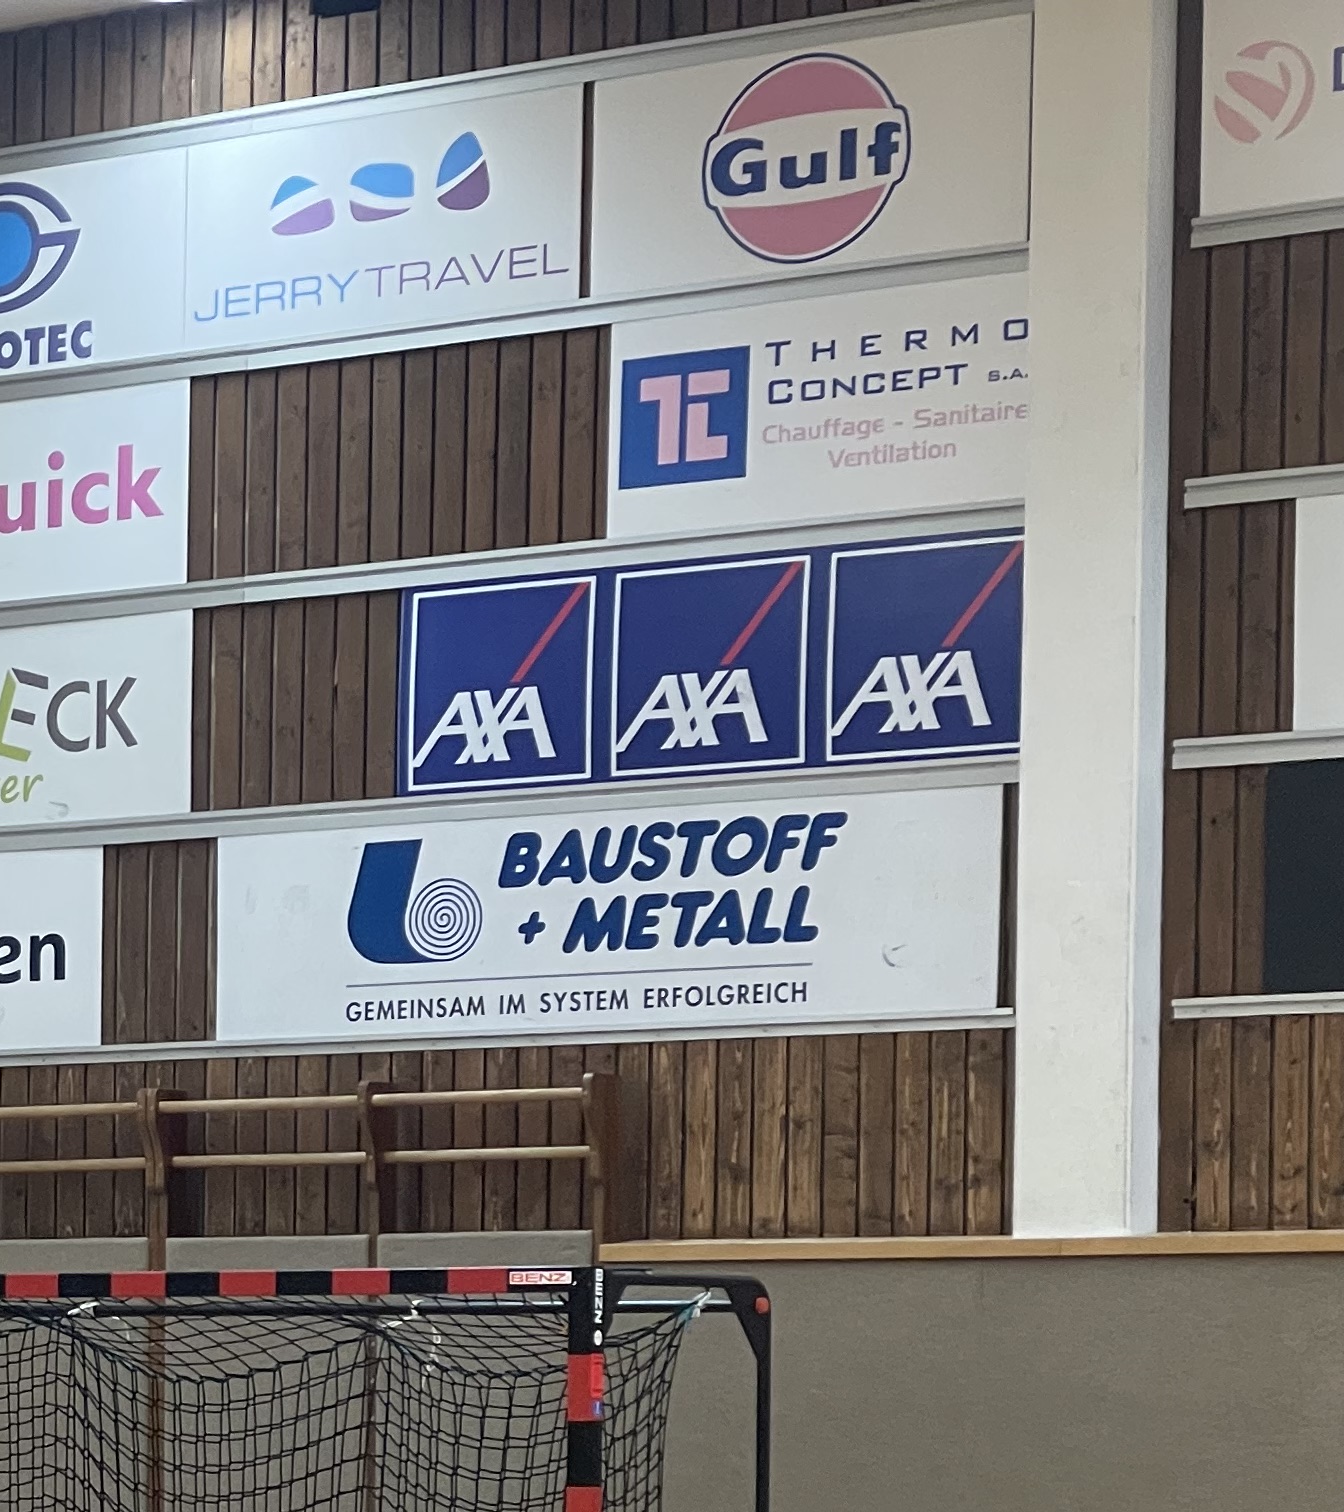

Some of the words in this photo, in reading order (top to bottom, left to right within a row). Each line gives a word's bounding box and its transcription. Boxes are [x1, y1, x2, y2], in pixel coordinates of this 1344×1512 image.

[710, 121, 901, 198] Gulf
[765, 318, 1029, 367] THERMO
[768, 363, 968, 405] CONCEPT
[762, 417, 885, 444] Chauffage
[828, 440, 957, 468] Ventilation
[615, 668, 768, 753] AXA
[831, 651, 991, 737] AXA
[413, 686, 556, 768] AXA
[498, 811, 848, 889] BAUSTOFF
[517, 911, 546, 945] +
[562, 885, 819, 954] METALL
[346, 996, 486, 1023] GEMEINSAM
[499, 993, 526, 1015] IM
[540, 989, 629, 1013] SYSTEM
[643, 981, 808, 1010] ERFOLGREICH
[511, 1272, 566, 1283] BENZ
[594, 1268, 604, 1324] BENZ
